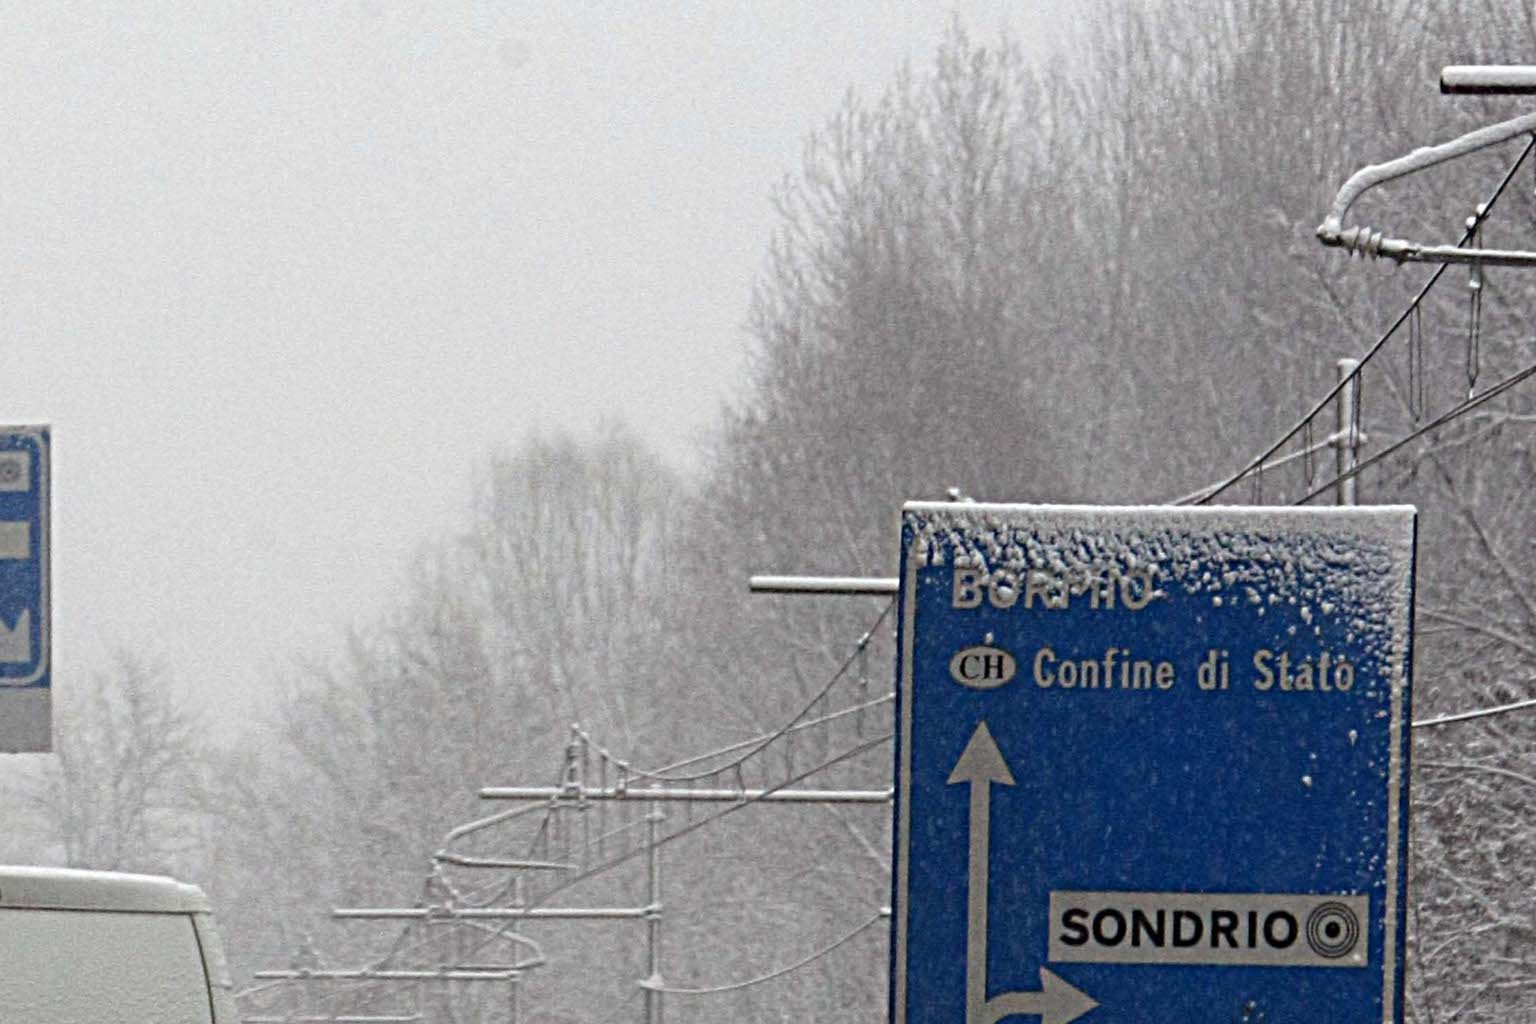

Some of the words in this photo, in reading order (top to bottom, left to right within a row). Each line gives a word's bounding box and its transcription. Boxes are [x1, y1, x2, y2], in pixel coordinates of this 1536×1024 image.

[958, 655, 1005, 681] CH
[1033, 646, 1175, 691] Confine
[1197, 650, 1230, 691] di
[1254, 649, 1357, 692] Stato
[1060, 908, 1298, 949] SONDRIO
